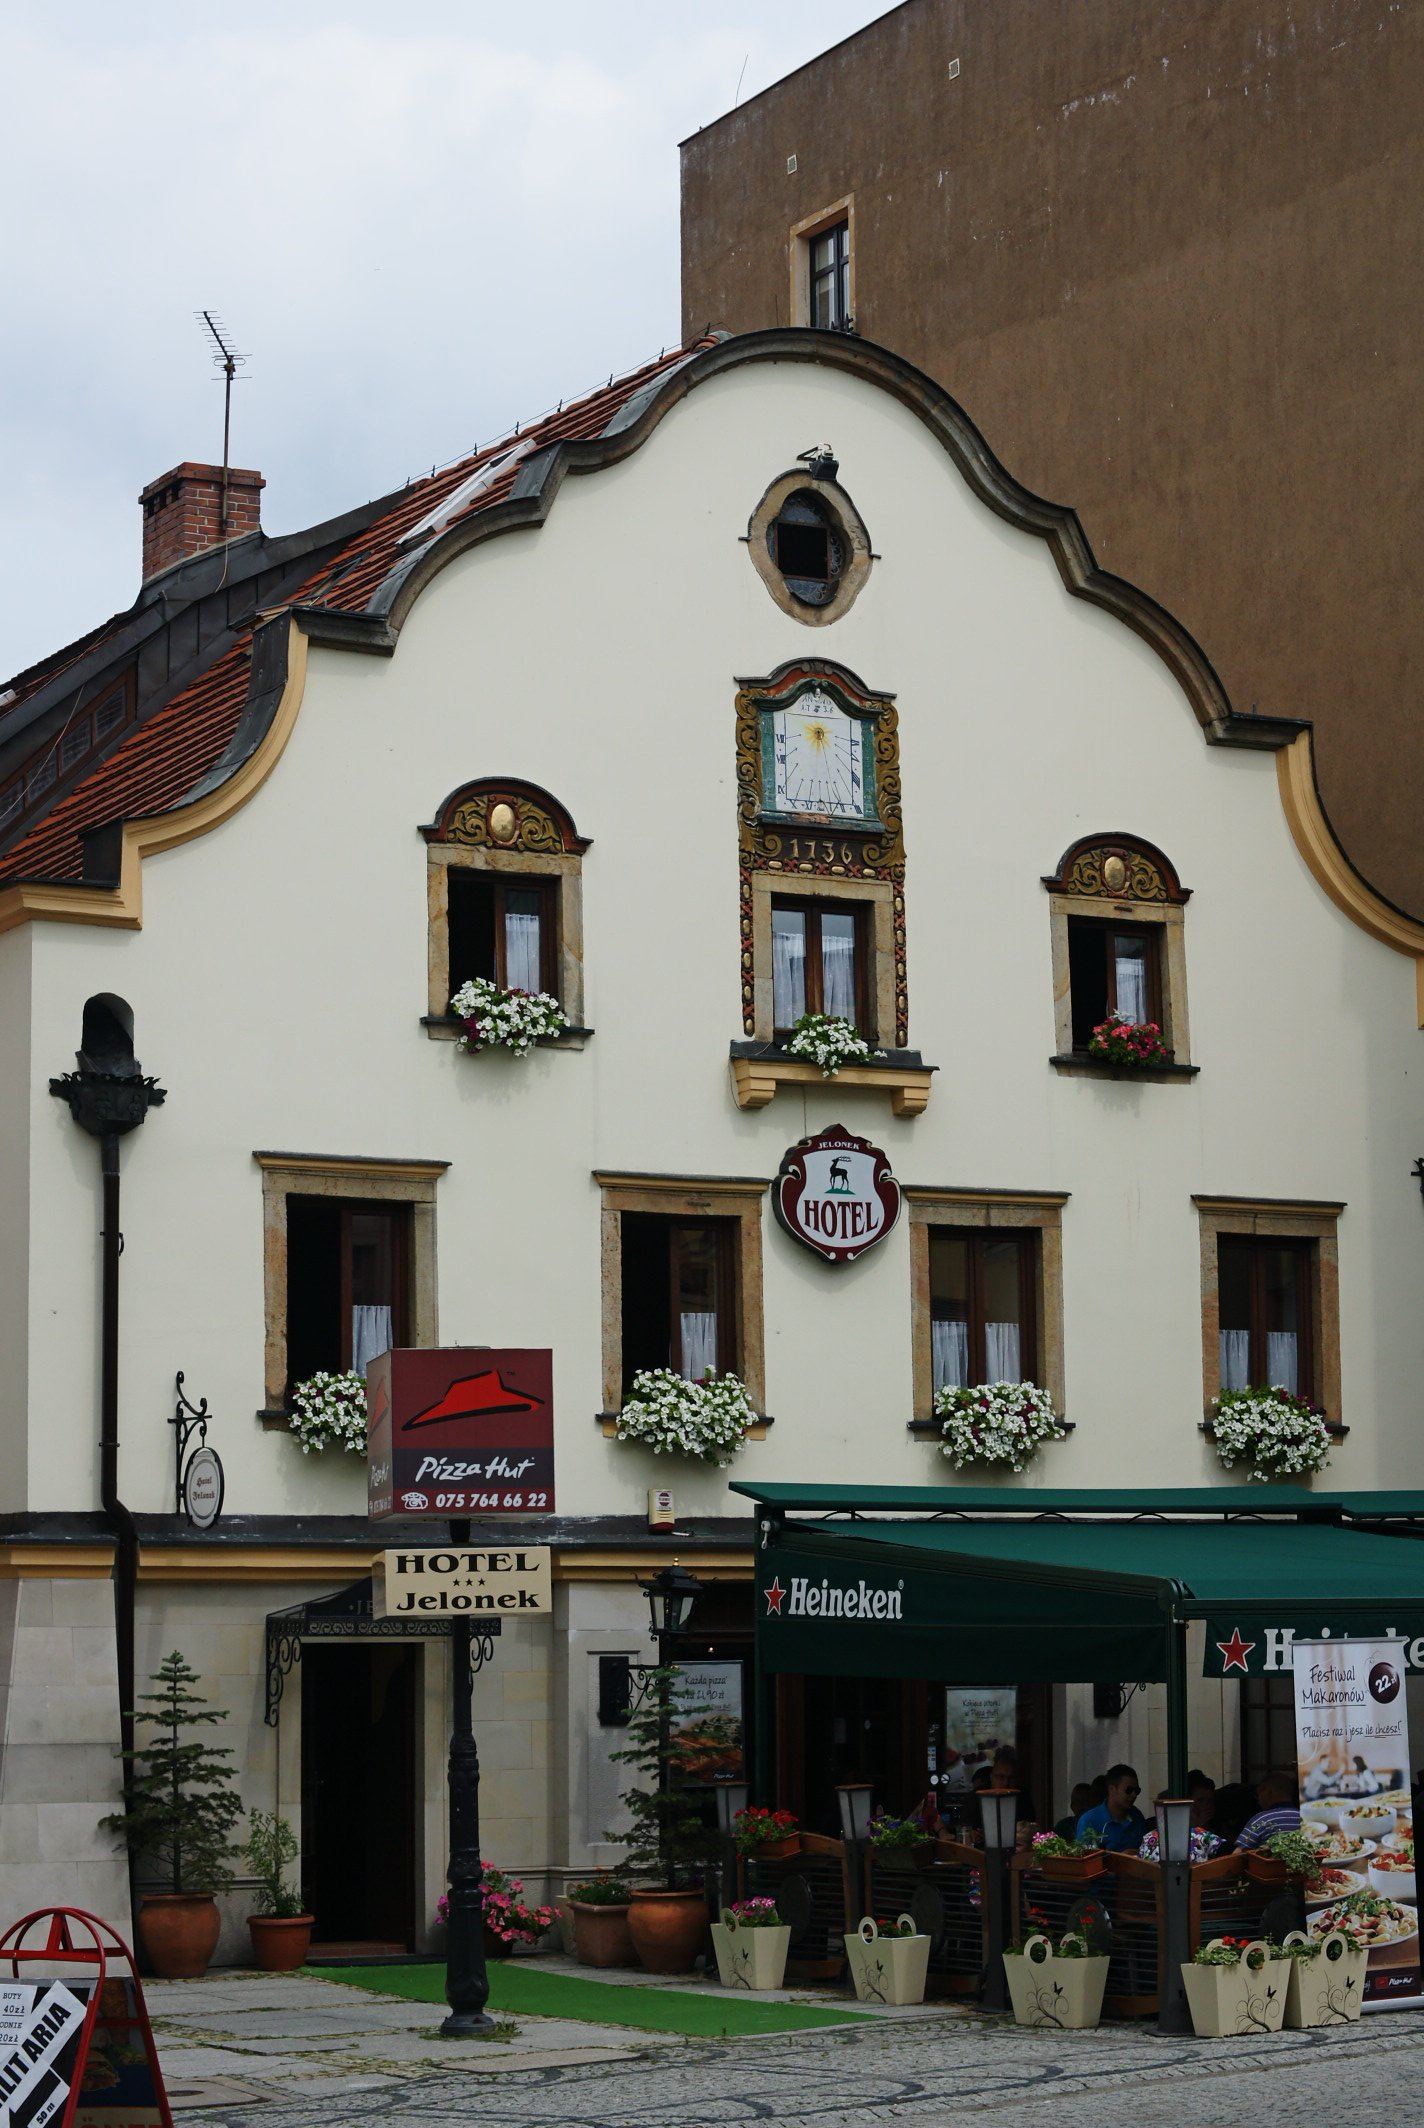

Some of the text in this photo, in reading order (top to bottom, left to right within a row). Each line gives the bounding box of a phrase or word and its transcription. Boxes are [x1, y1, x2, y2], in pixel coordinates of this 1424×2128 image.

[790, 838, 853, 865] 1736
[818, 1141, 860, 1150] JELONEK
[803, 1200, 879, 1239] HOTEL
[414, 1456, 482, 1482] Pizza
[484, 1456, 535, 1480] Hut
[435, 1492, 547, 1508] 075 764 66 22
[396, 1552, 540, 1574] HOTEL
[396, 1590, 540, 1611] Jelonek
[788, 1577, 903, 1619] Heineken
[1309, 1664, 1356, 1684] Festiwal
[1375, 1674, 1392, 1693] 22
[1302, 1687, 1365, 1704] Makaronów
[1332, 1728, 1343, 1737] raz
[1347, 1724, 1363, 1743] jesz
[1365, 1724, 1374, 1735] ile
[3, 1992, 22, 2000] BUTY
[36, 2110, 48, 2124] 50
